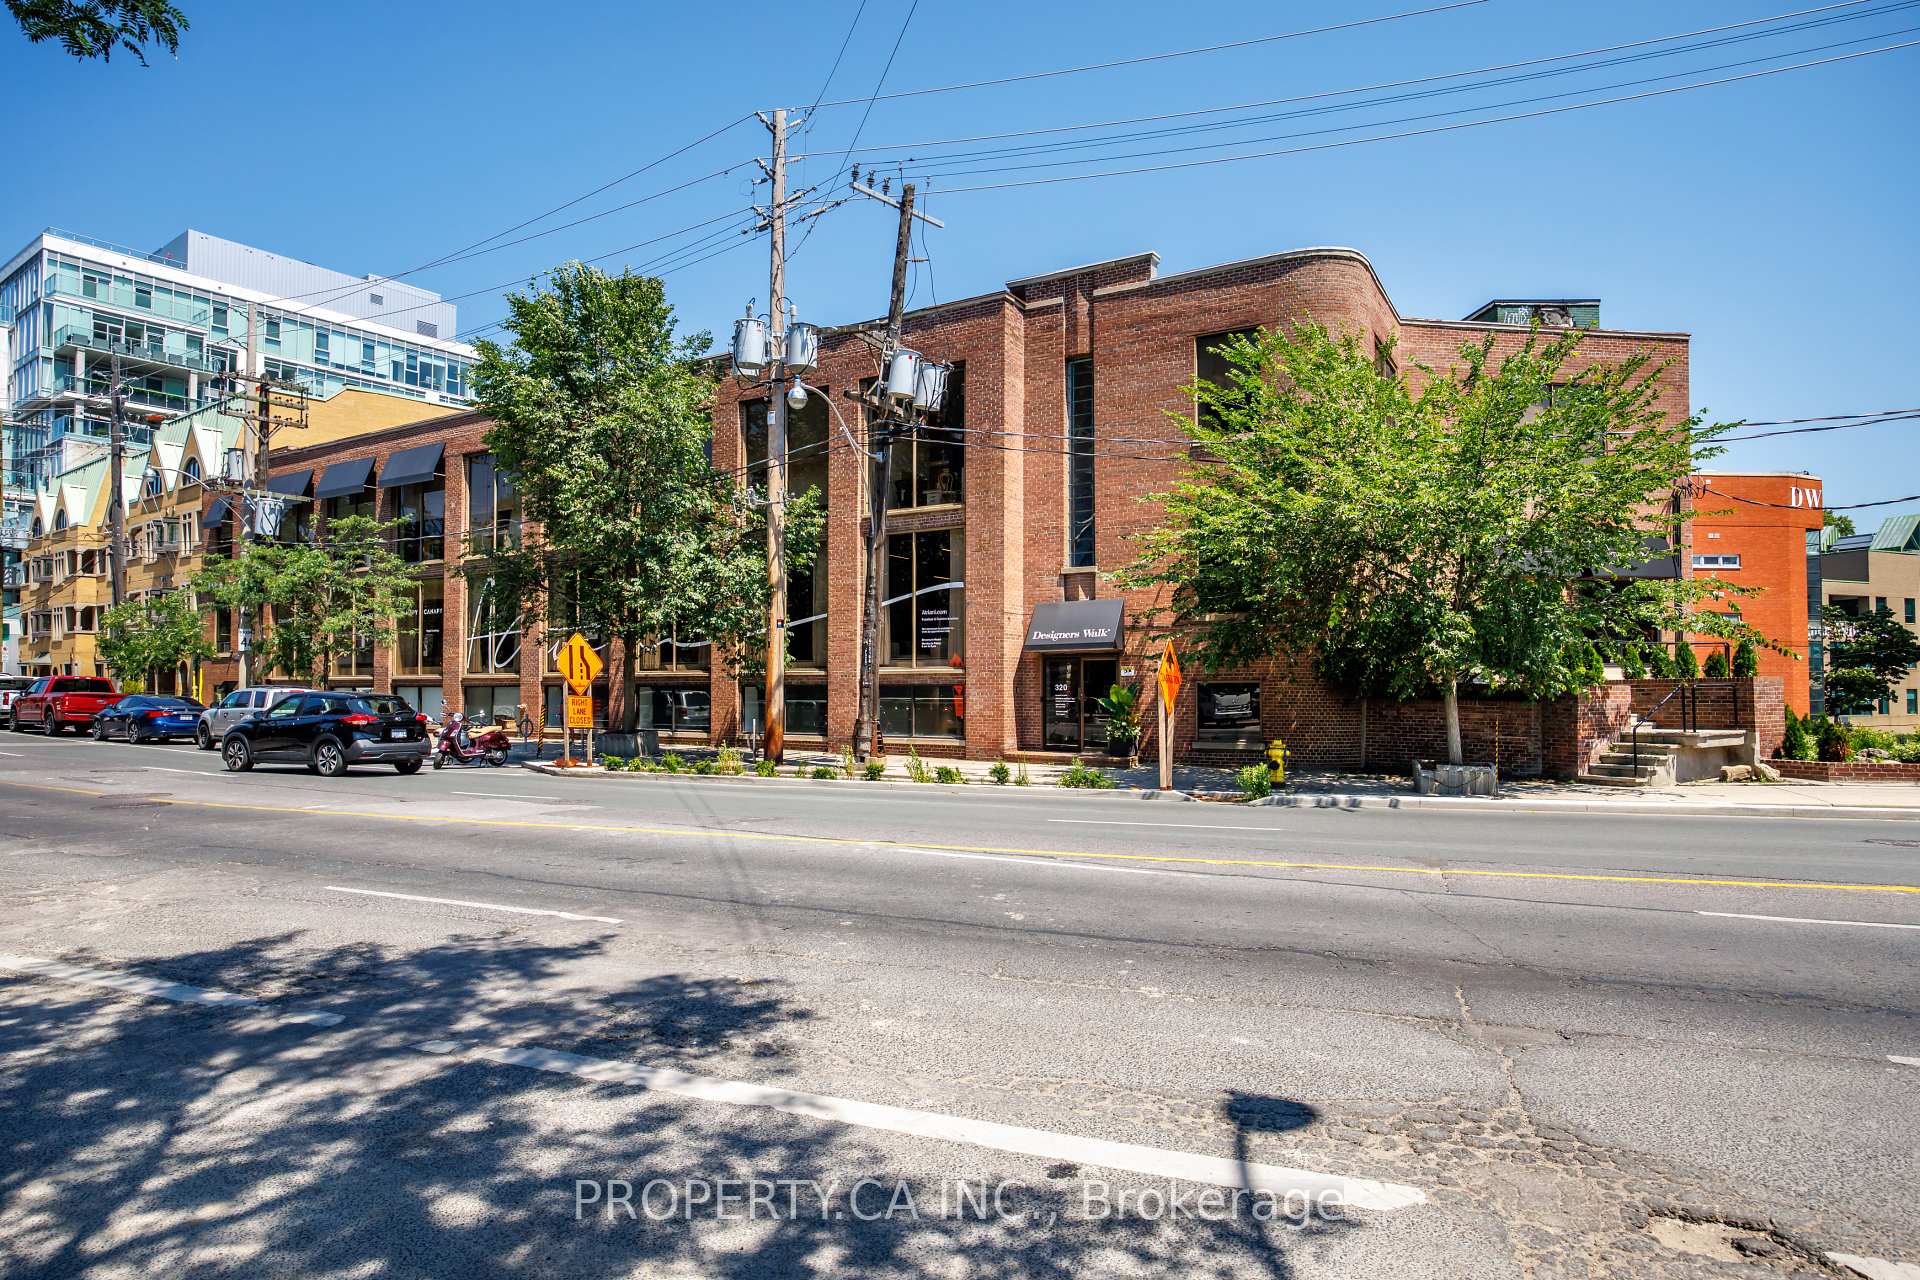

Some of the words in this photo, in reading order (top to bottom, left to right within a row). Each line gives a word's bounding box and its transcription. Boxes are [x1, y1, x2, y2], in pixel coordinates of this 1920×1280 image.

[1790, 486, 1822, 508] DW
[1032, 630, 1080, 641] Designers
[571, 698, 588, 707] RIGHT
[572, 707, 587, 716] LANE
[569, 716, 592, 725] CLOSED
